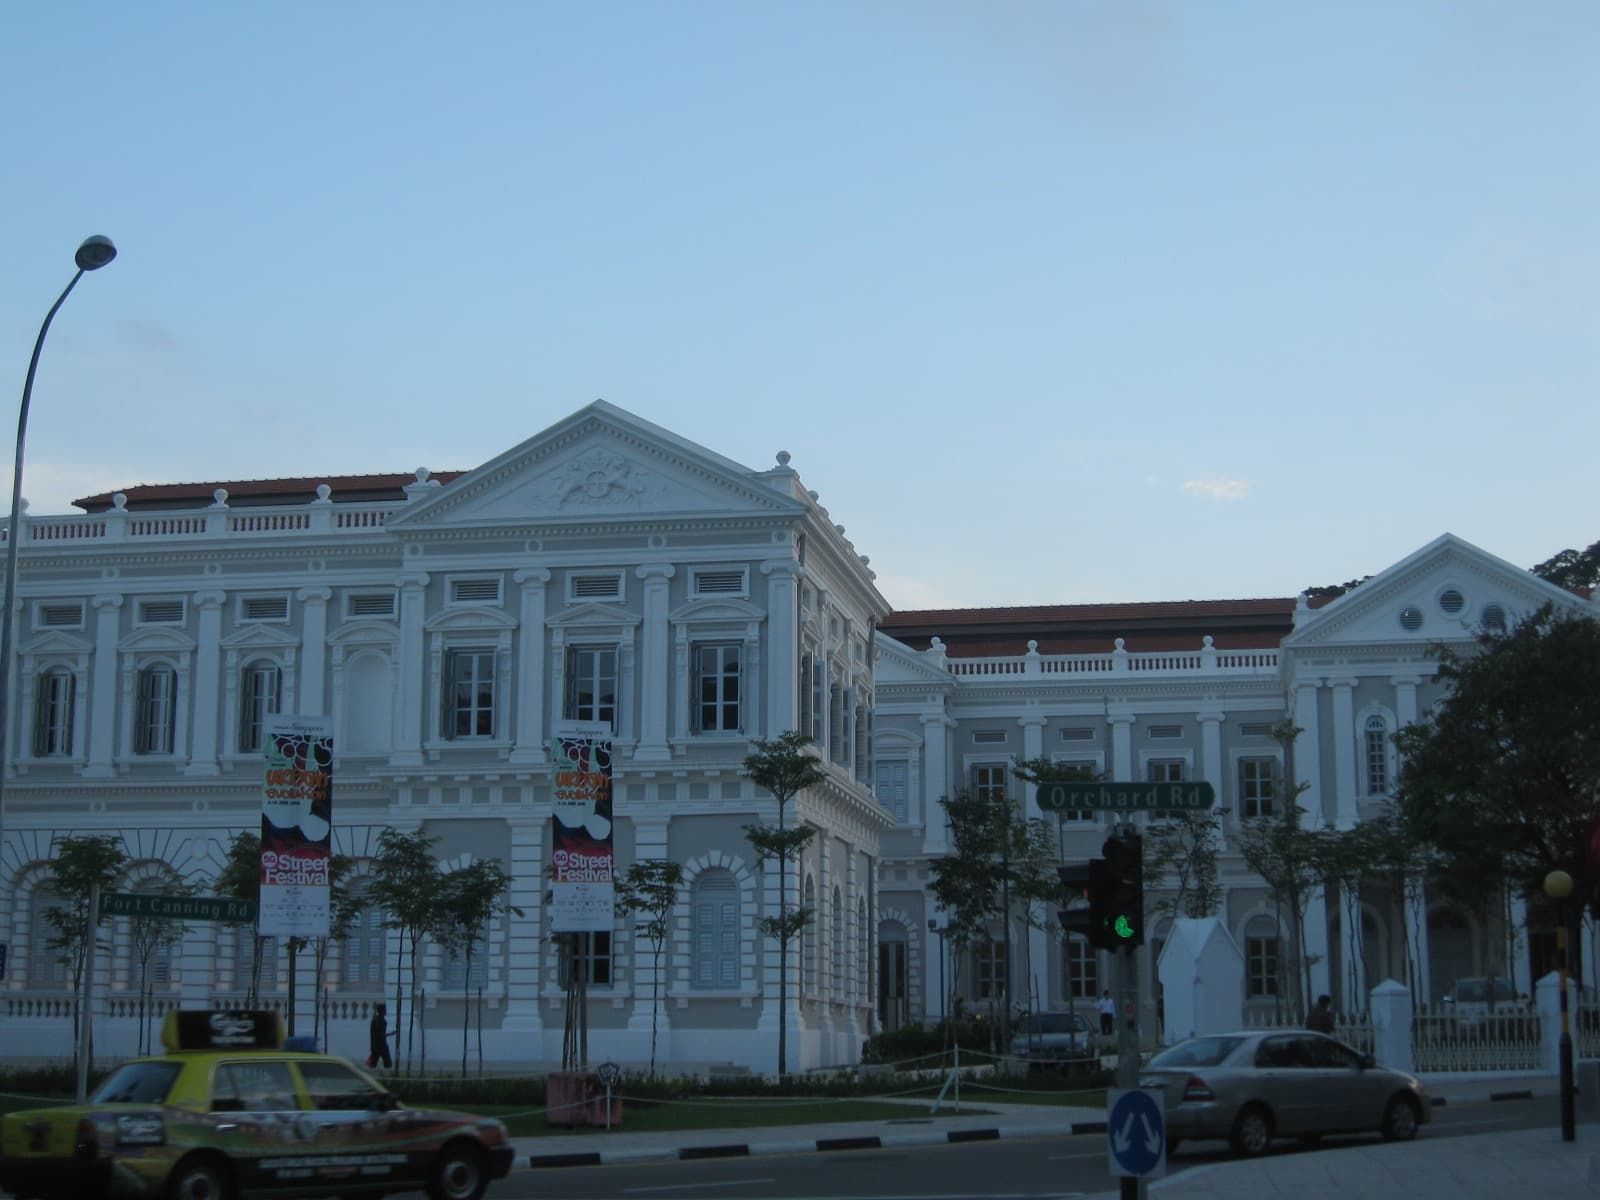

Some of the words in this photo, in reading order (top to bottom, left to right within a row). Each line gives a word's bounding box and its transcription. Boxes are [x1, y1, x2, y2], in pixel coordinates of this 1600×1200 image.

[1051, 786, 1157, 807] Orchard
[1171, 786, 1199, 806] Rd
[278, 854, 329, 871] Street
[568, 852, 612, 868] Street
[265, 868, 328, 885] Festival
[558, 865, 612, 882] Festival
[104, 895, 140, 910] Fort
[150, 898, 220, 919] Canning
[228, 903, 248, 917] Rd
